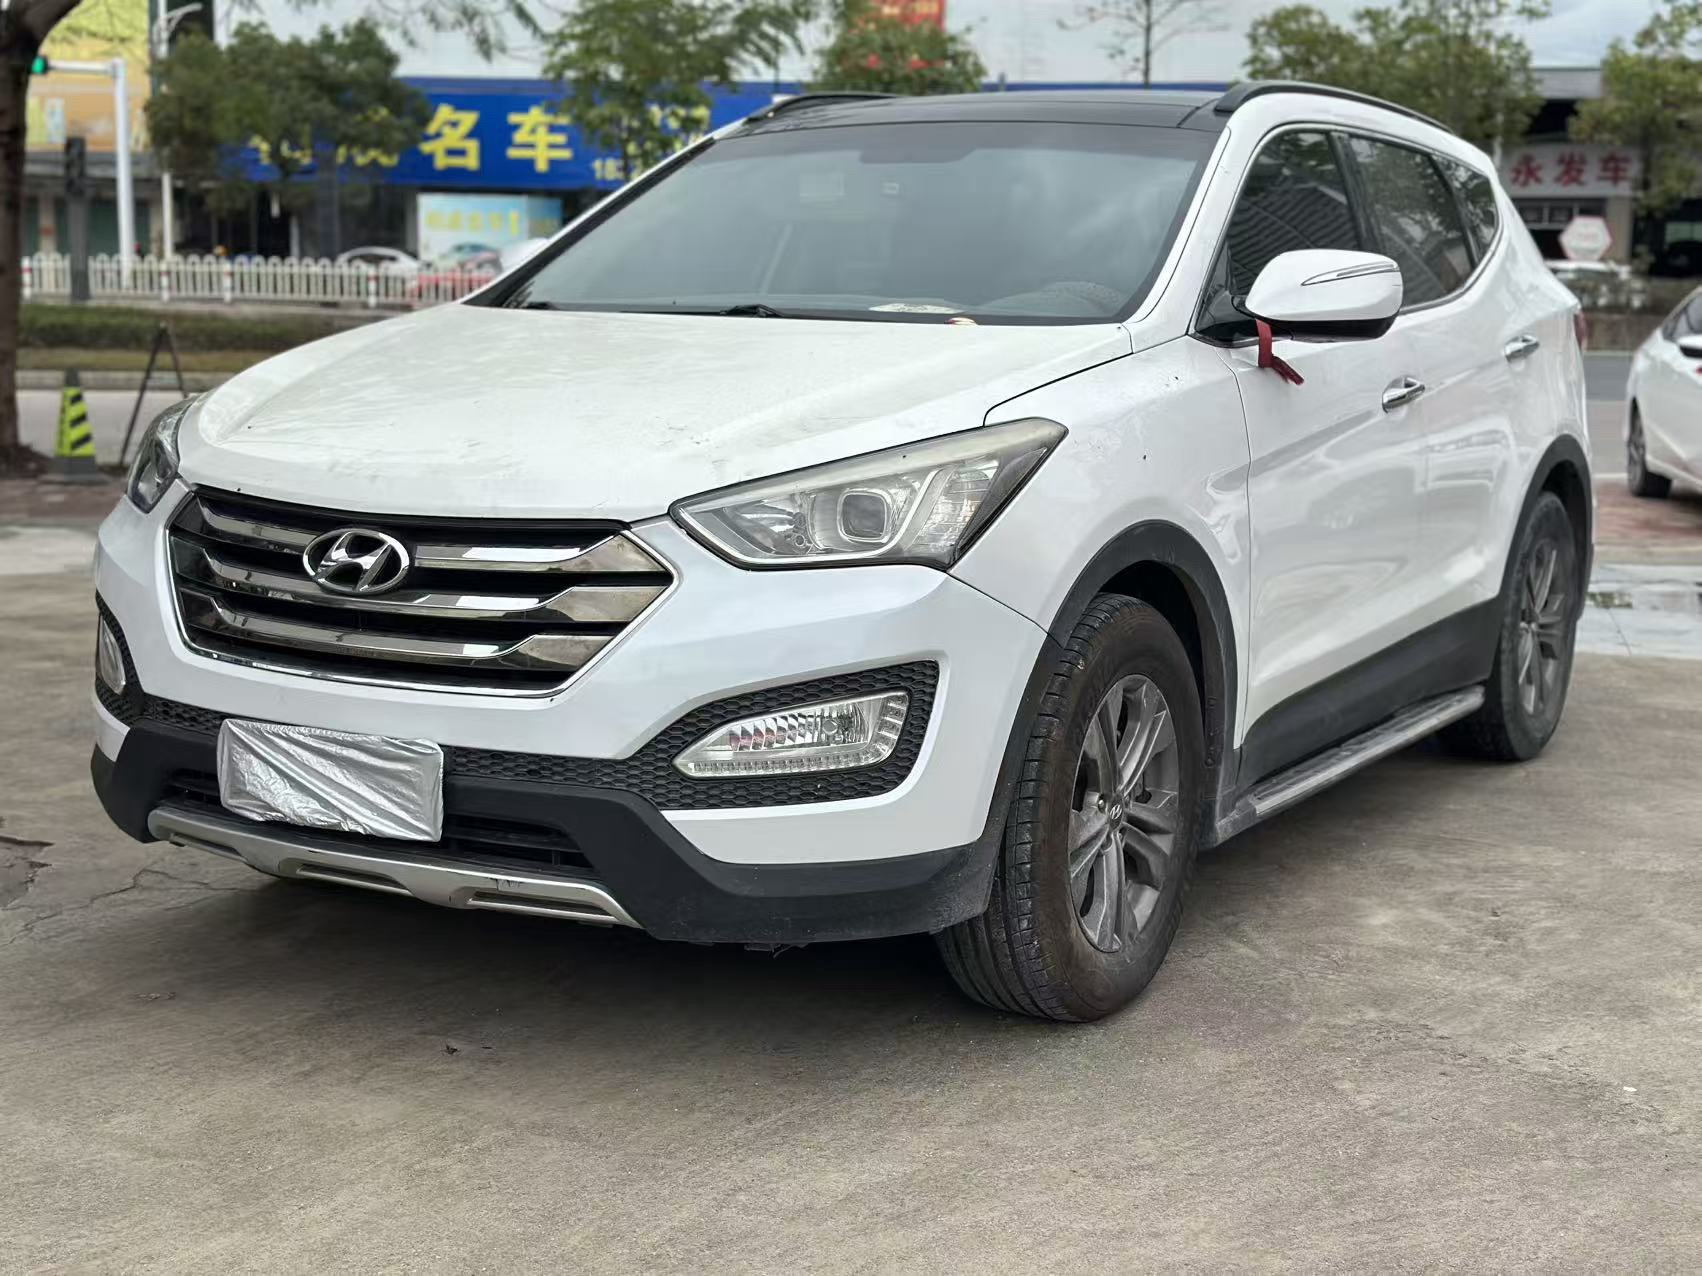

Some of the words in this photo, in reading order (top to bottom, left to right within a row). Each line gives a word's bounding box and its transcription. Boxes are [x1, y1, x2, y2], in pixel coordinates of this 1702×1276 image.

[419, 103, 573, 173] 名车
[1511, 152, 1633, 187] 永发车
